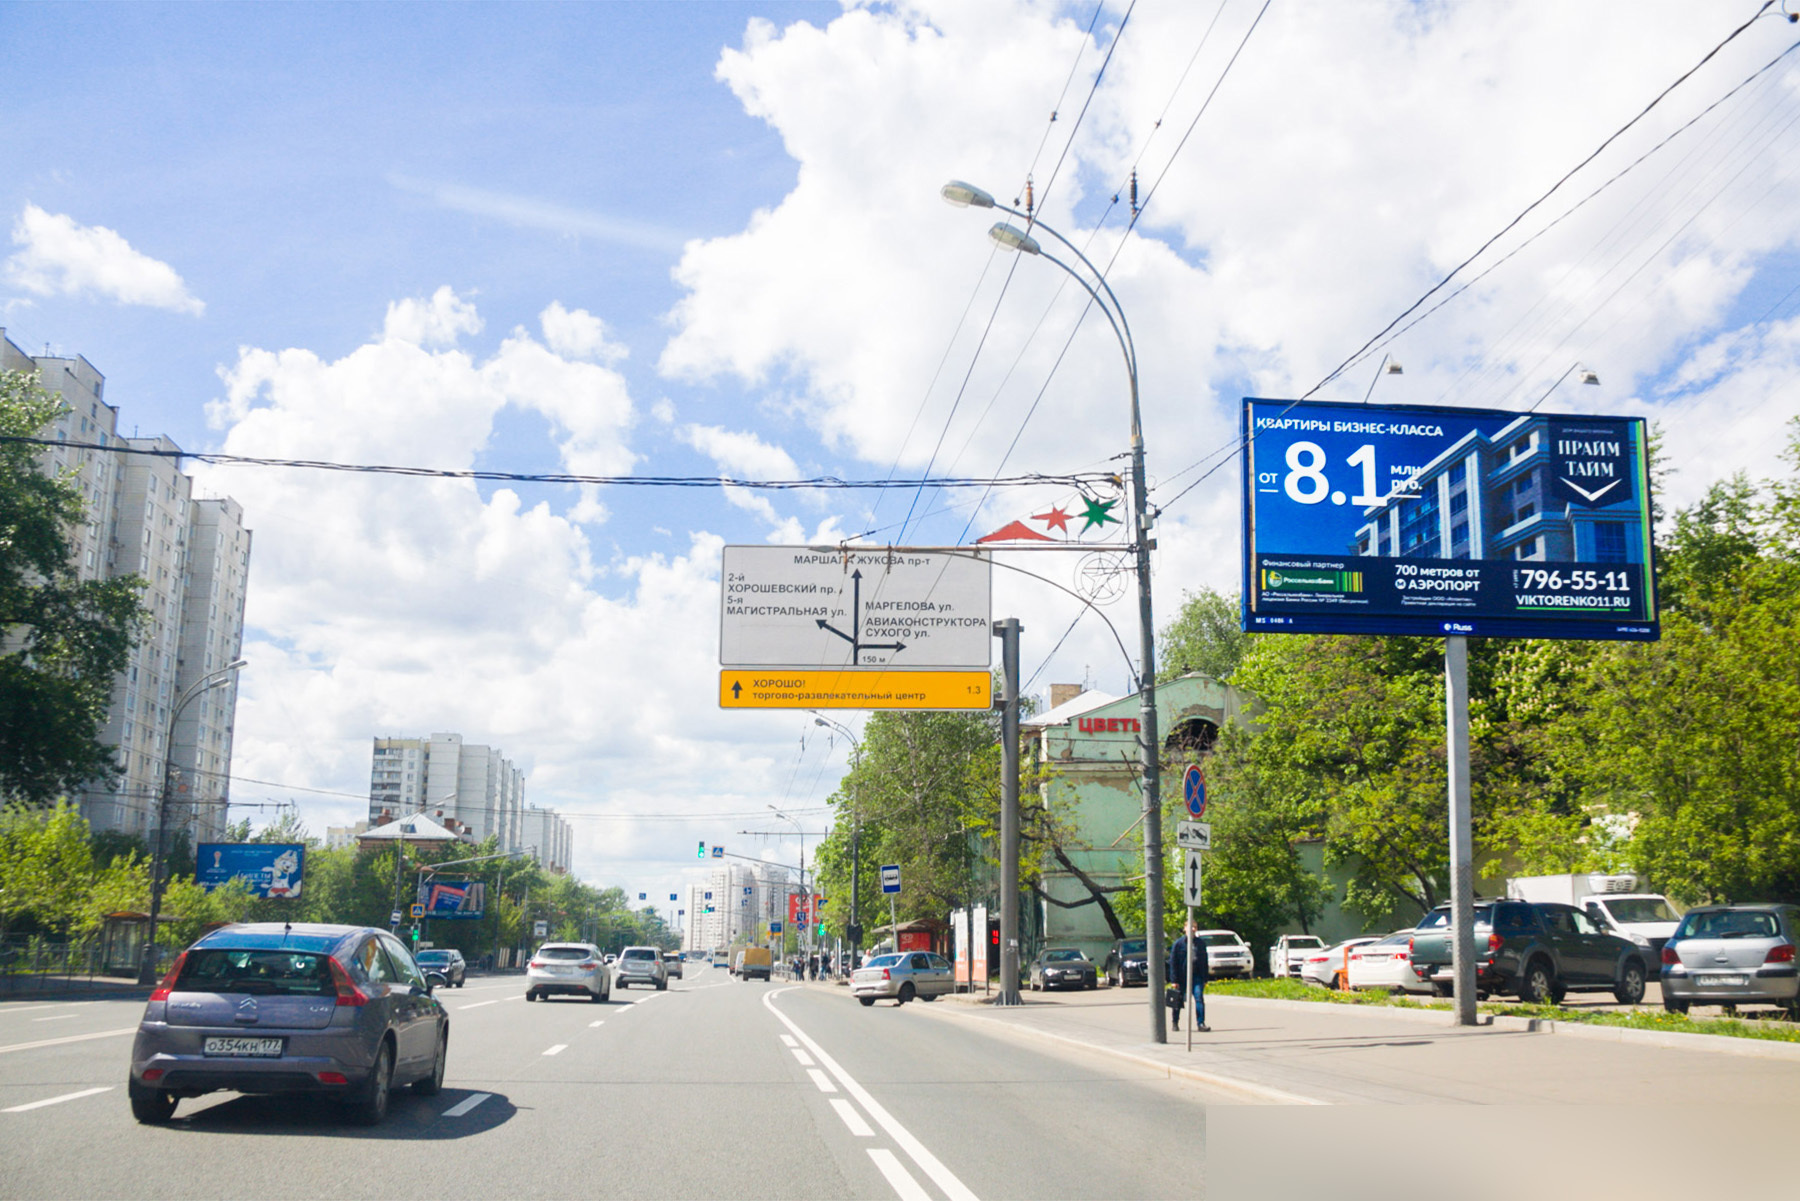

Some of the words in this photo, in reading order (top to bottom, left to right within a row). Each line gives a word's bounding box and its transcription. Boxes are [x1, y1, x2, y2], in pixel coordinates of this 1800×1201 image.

[1256, 417, 1331, 432] КВАРТИРЫ
[1334, 421, 1444, 437] БИЗНЕС-КЛАССА
[1558, 440, 1620, 457] ПРАЙМ
[1284, 441, 1388, 507] 8.1
[1565, 461, 1614, 478] ТАЙМ
[857, 555, 905, 565] ЖУКОВА
[908, 557, 931, 567] пр-т
[1262, 559, 1312, 568] Финансовый
[1313, 561, 1345, 570] партнер
[728, 572, 745, 582] 2-й
[1394, 564, 1418, 576] 700
[1420, 567, 1464, 579] метров
[1465, 569, 1480, 578] от
[1408, 579, 1481, 592] АЭРОПОРТ
[1520, 569, 1631, 591] 796-55-11
[728, 583, 817, 593] ХОРОШЕВСКИЙ
[820, 586, 837, 595] пр.
[727, 595, 744, 605] 5-я
[1515, 594, 1631, 607] VIKTORENKO11.RU
[726, 606, 828, 616] МАГИСТРАЛЬНАЯ
[831, 609, 847, 618] ул.
[865, 601, 936, 611] МАРГЕЛОВА
[938, 603, 955, 613] ул.
[865, 617, 987, 627] АВИАКОНСТРУКТОРА
[865, 628, 912, 638] СУХОГО
[914, 630, 931, 640] ул.
[753, 679, 806, 688] ХОРОШО!
[753, 691, 892, 701] торгово-развлекательный
[895, 692, 926, 701] центр
[966, 686, 982, 695] 1.3
